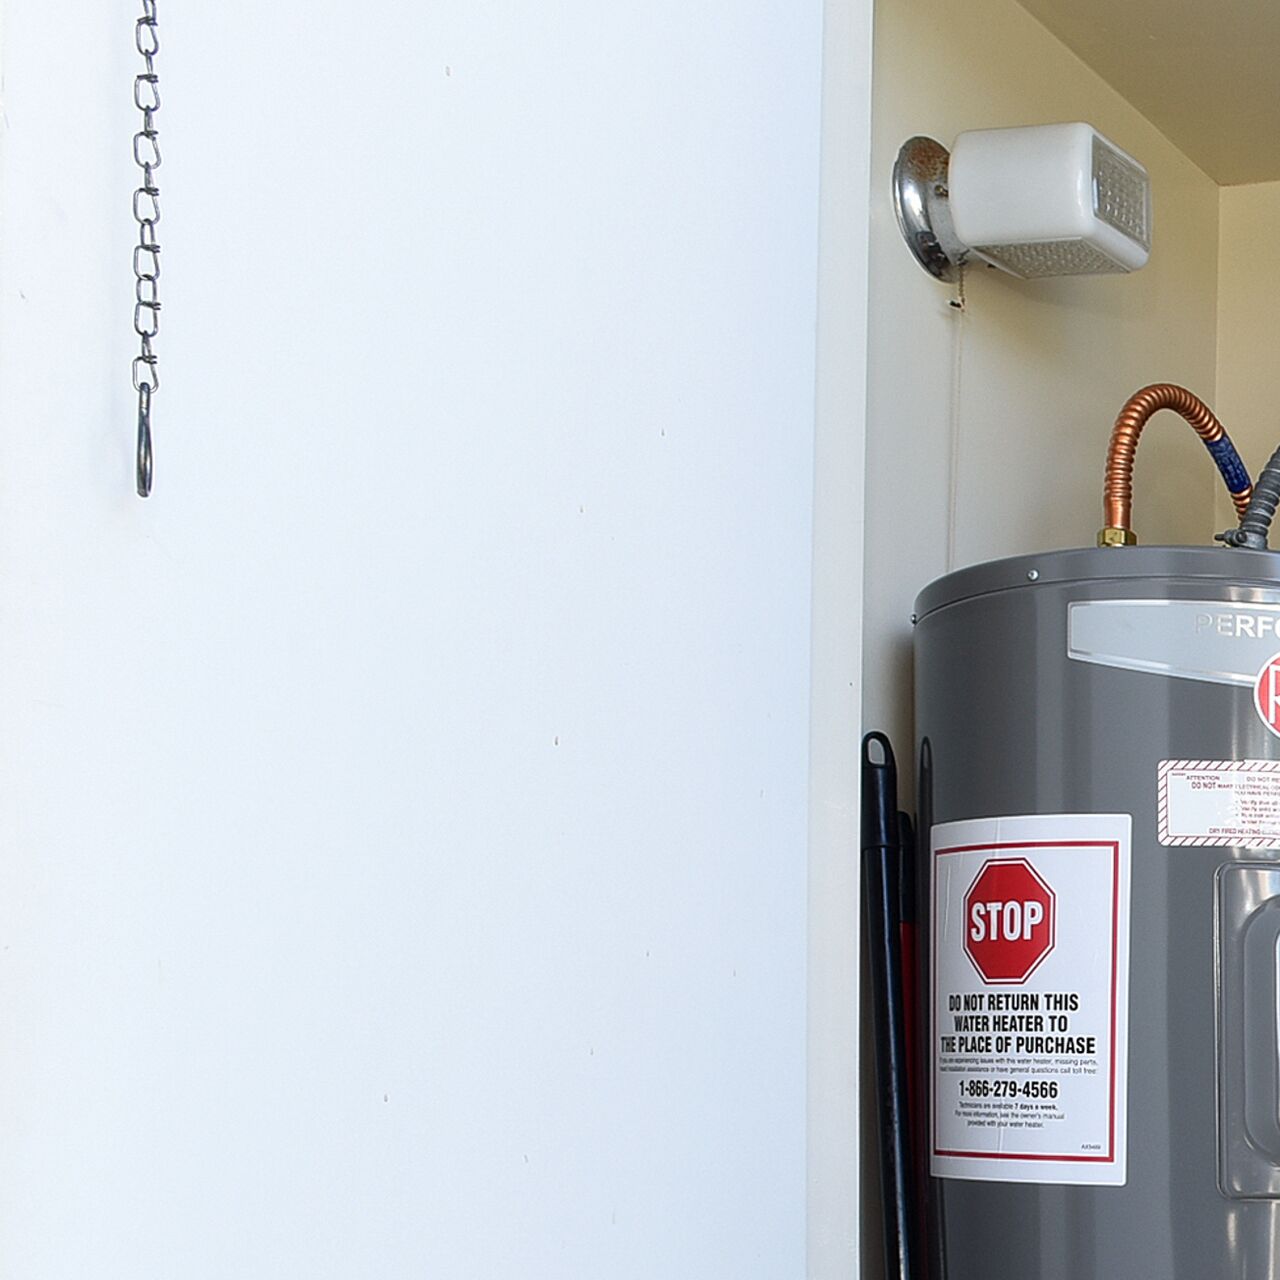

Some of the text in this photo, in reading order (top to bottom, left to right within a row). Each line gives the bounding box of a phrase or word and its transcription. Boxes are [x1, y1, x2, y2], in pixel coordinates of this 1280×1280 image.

[971, 901, 1044, 942] STOP
[949, 994, 1079, 1011] DO NOT RETURN THIS
[954, 1015, 1068, 1032] WATER HEATER TO
[941, 1036, 1095, 1054] THE PLACE OF PURCHASE
[959, 1080, 1058, 1098] 1-866-279-4566
